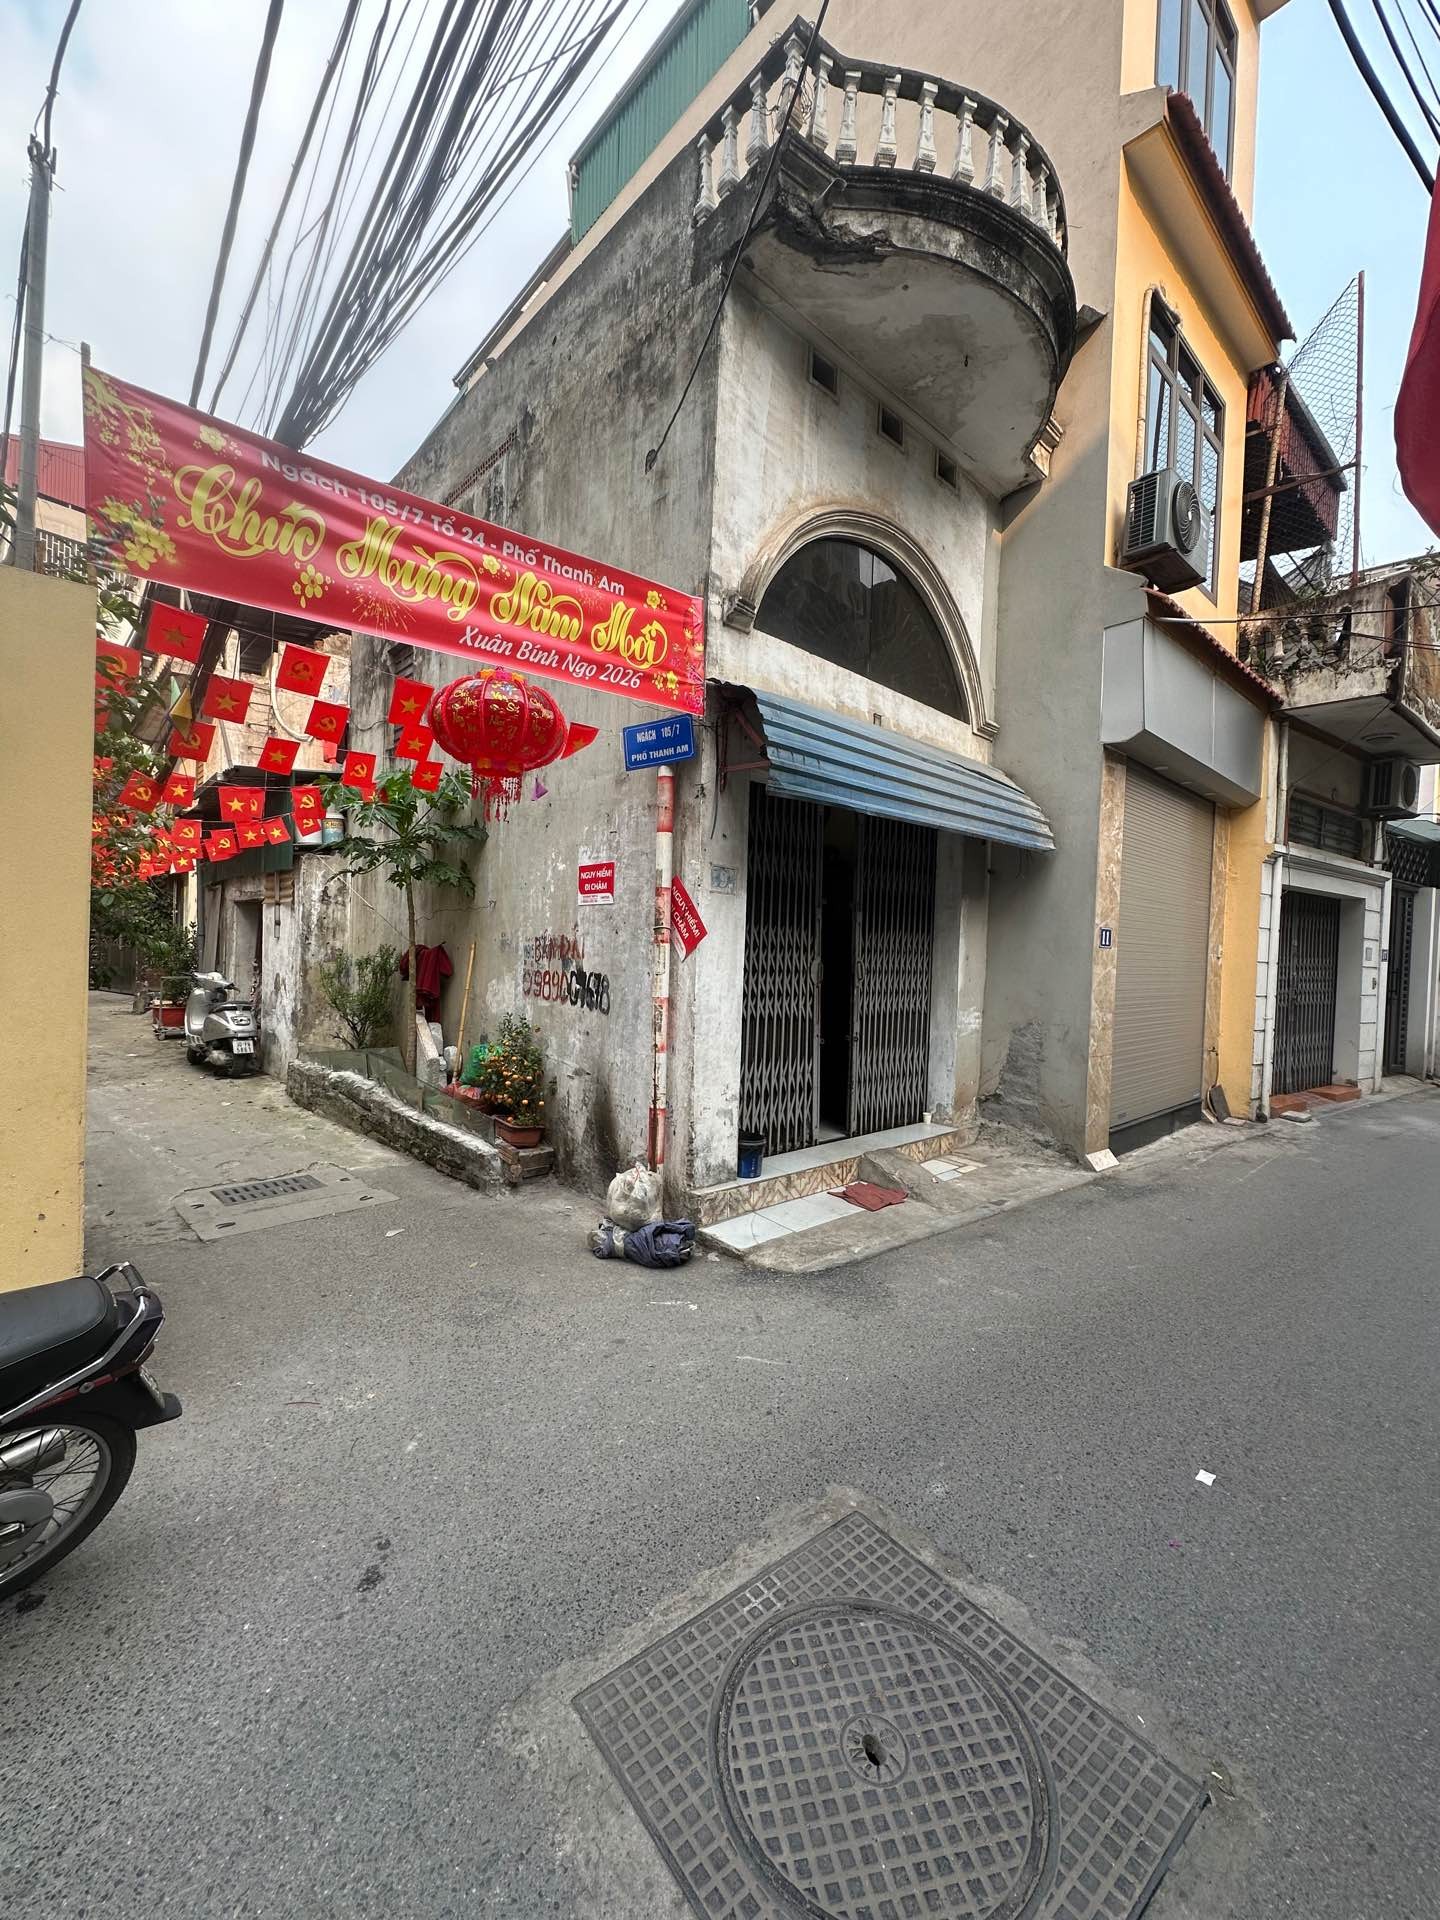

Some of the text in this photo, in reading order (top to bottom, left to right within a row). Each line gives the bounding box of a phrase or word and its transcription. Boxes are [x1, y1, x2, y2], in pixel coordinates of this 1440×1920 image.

[261, 451, 349, 498] Ngách
[357, 487, 424, 525] 105/7
[431, 515, 456, 537] Tổ
[461, 526, 486, 549] 24
[503, 540, 541, 566] Phố
[542, 554, 594, 586] Thanh
[598, 575, 625, 596] Am
[172, 463, 668, 670] Chúc Mừng Năm Mới
[458, 625, 644, 689] Xuân Bính Ngọ 2026
[649, 747, 674, 759] THANH
[676, 744, 689, 754] AM
[580, 871, 596, 880] NGUY
[672, 886, 688, 910] NGUY
[1102, 931, 1110, 945] 11
